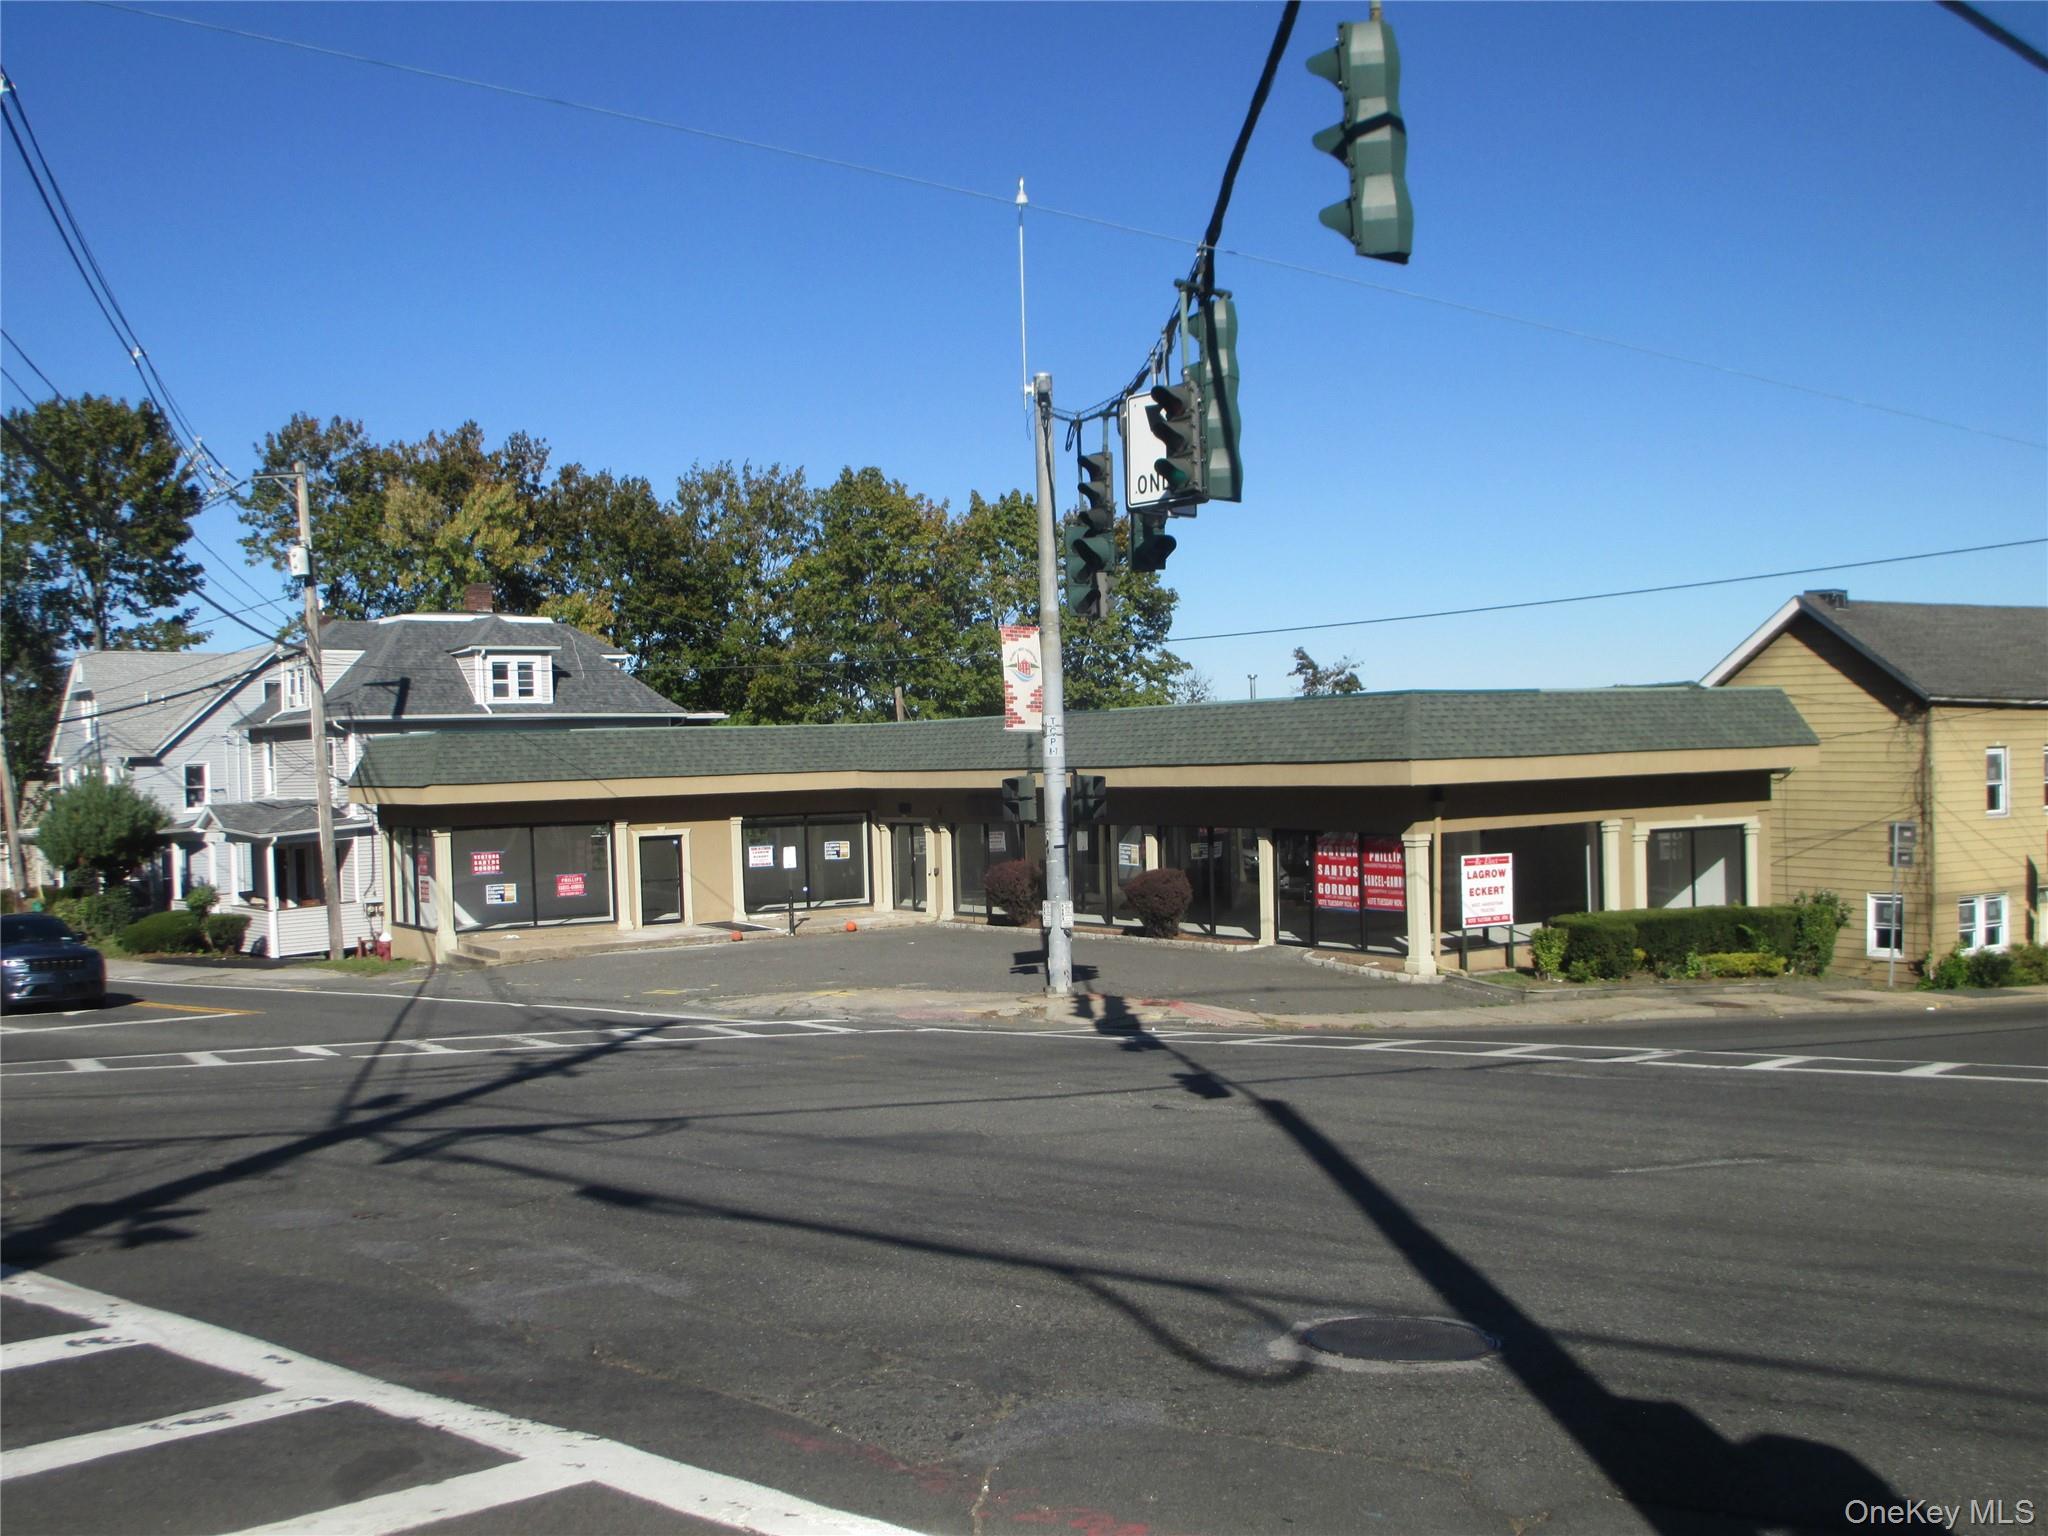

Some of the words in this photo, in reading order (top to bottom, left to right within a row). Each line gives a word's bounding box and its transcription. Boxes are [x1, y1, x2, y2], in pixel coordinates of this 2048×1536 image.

[1369, 850, 1402, 862] PHILLIP
[1317, 864, 1359, 878] SANTOS
[1466, 868, 1507, 880] LAGROW
[1317, 882, 1359, 897] GORDON
[1469, 885, 1505, 897] ECKERT
